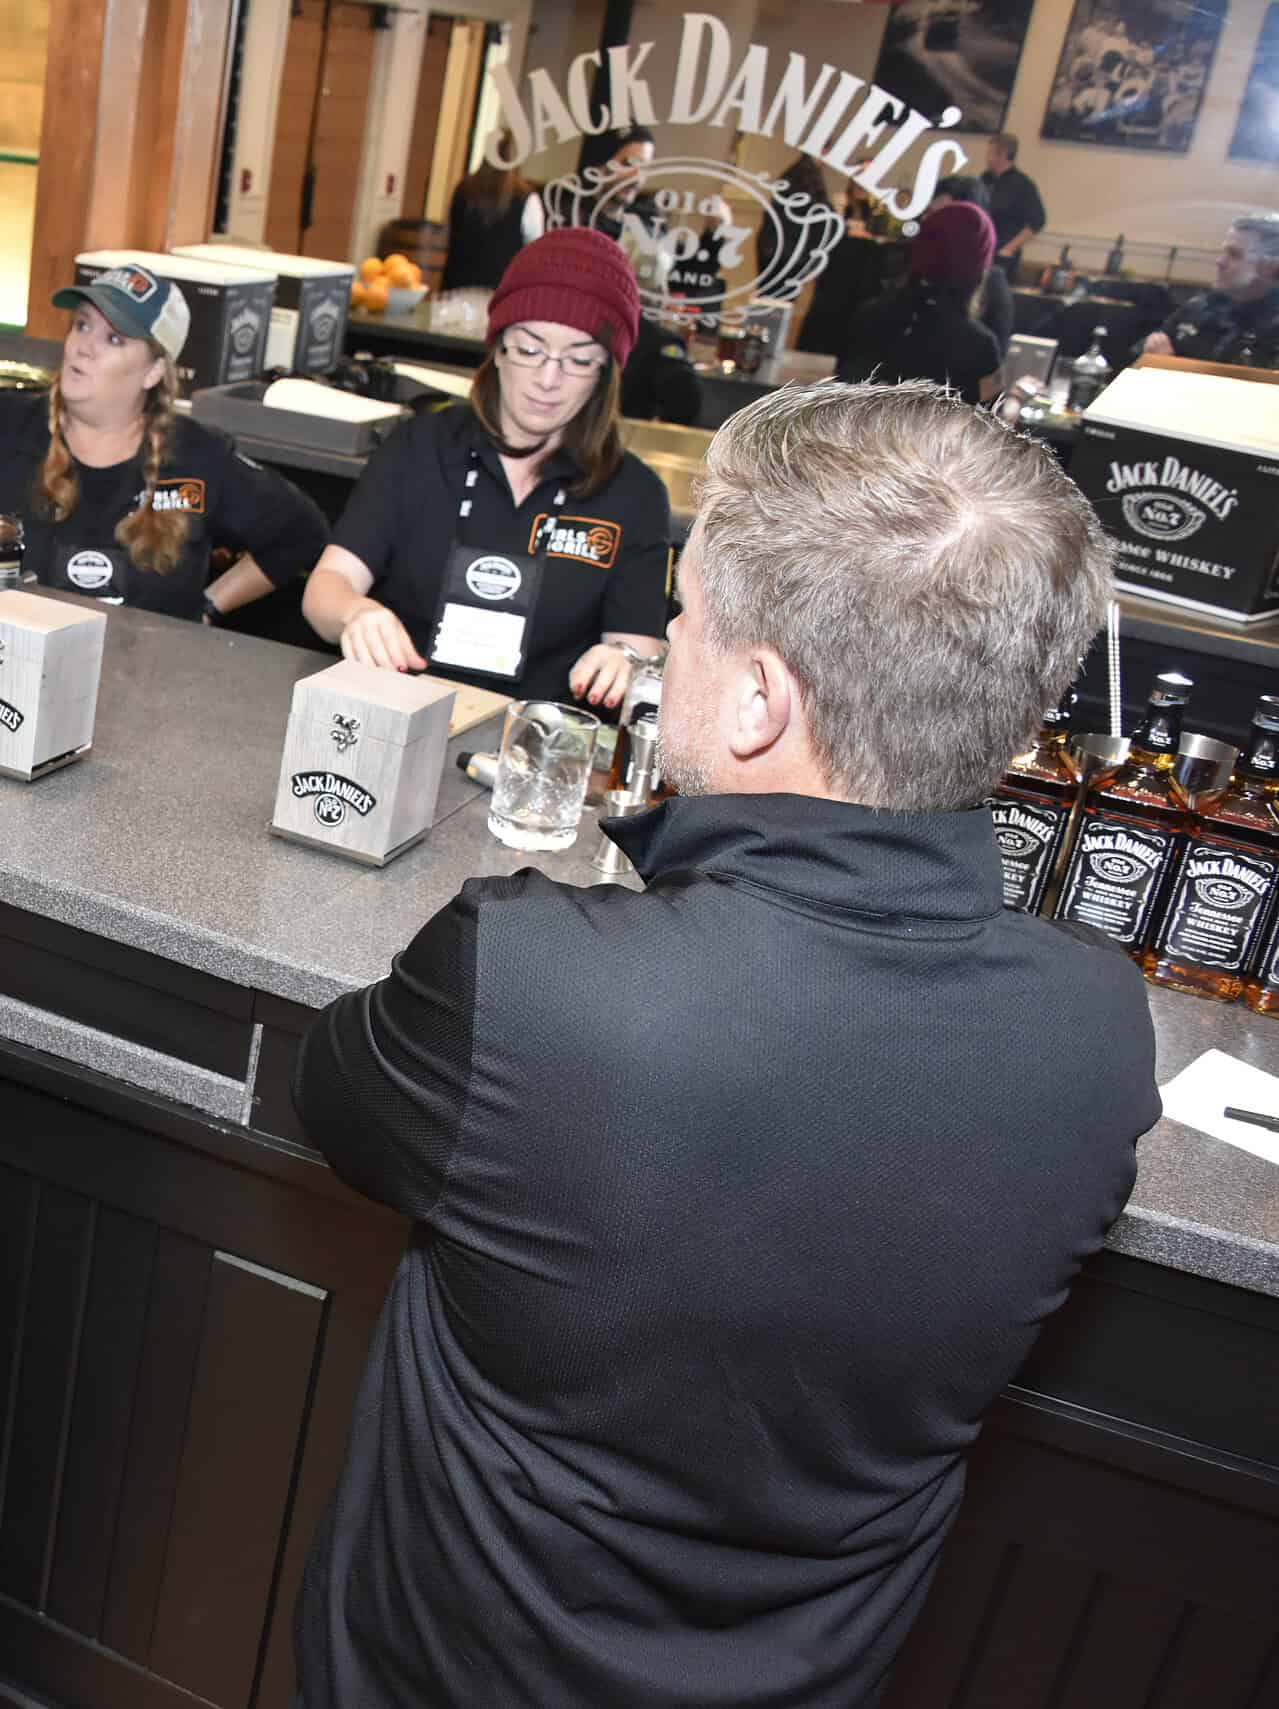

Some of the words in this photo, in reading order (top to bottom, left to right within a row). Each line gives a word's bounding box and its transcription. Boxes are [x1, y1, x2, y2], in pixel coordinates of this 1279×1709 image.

[484, 41, 659, 171] JACK
[669, 12, 969, 221] DANIEL'S
[654, 188, 723, 215] Old
[1106, 460, 1160, 493] JACK
[1160, 456, 1239, 521] DANIEL'S
[1155, 548, 1236, 580] WHISKEY
[294, 775, 325, 796] JACK
[1082, 833, 1115, 853] JACK
[1115, 832, 1164, 870] DANIEL'S
[1186, 859, 1221, 879] JACK
[1221, 857, 1271, 896] DANIEL'S
